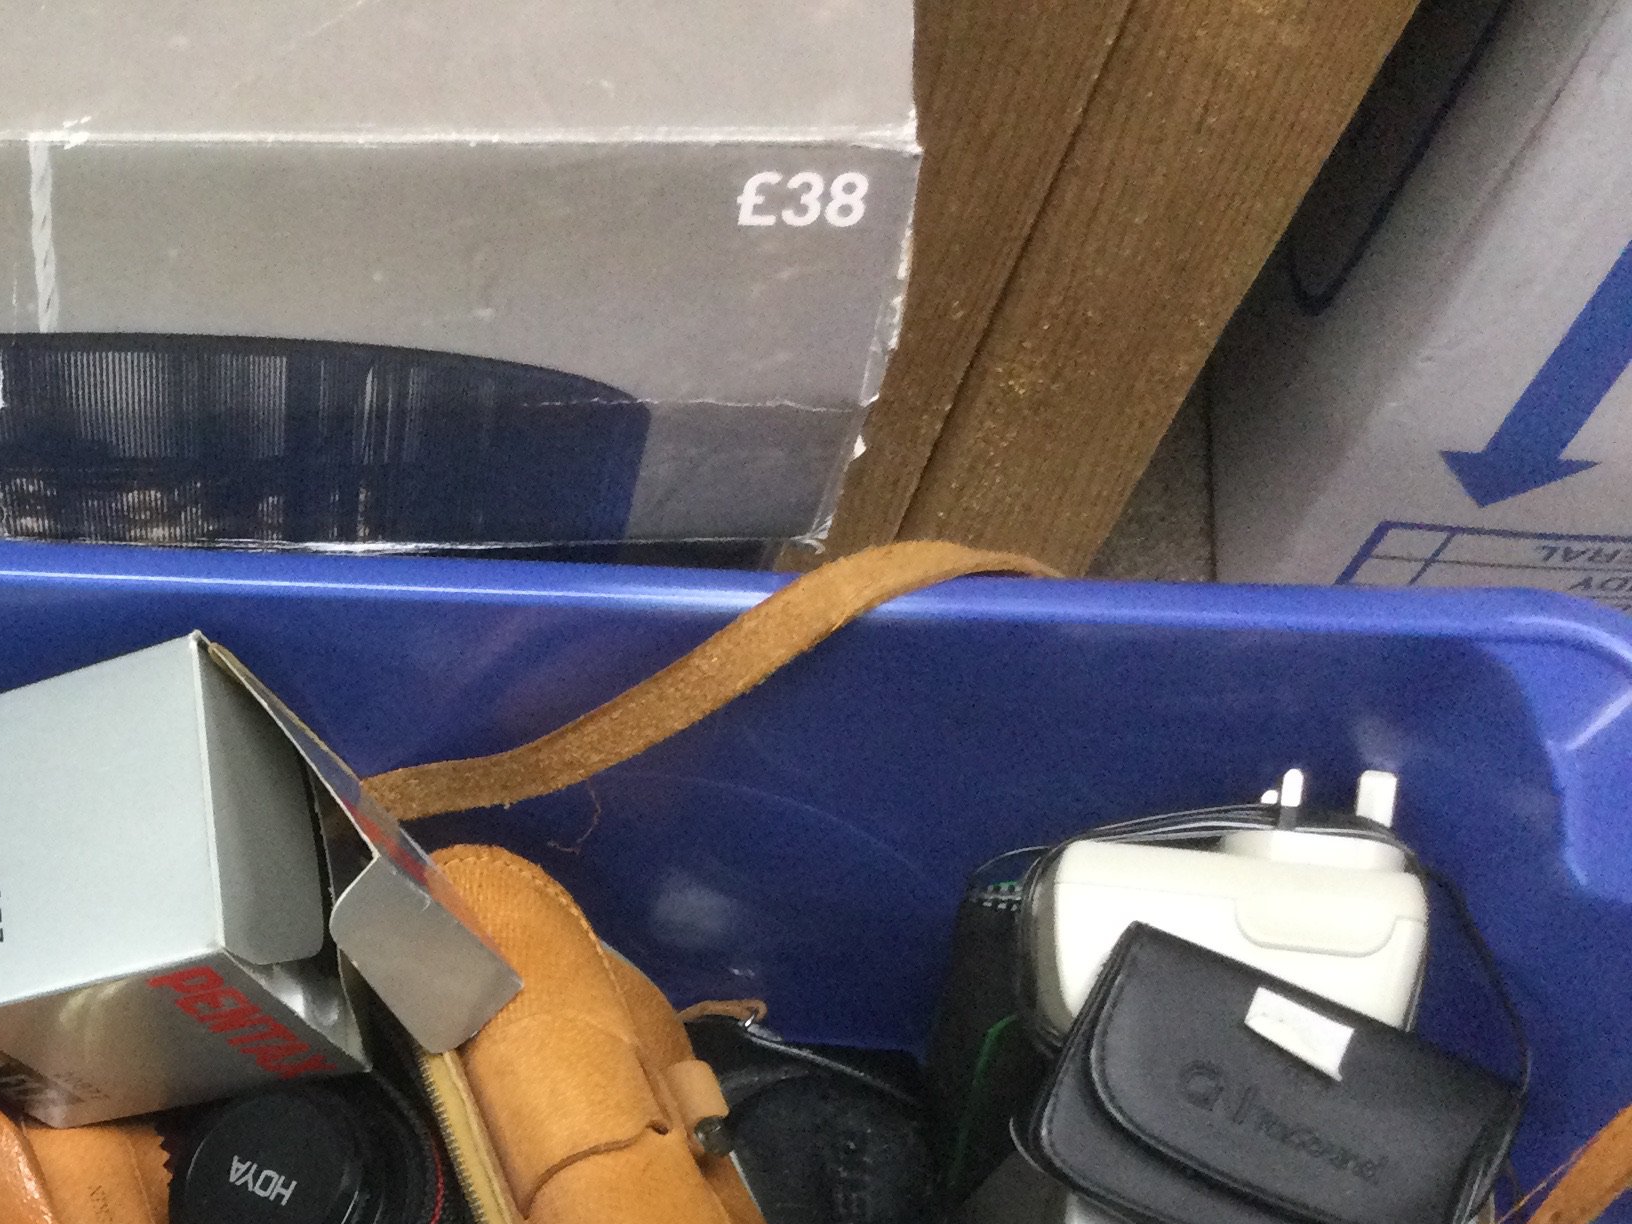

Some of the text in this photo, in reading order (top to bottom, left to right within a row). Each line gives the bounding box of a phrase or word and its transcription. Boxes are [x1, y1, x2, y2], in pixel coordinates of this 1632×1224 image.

[737, 170, 869, 228] £38
[146, 965, 338, 1081] PENTAX
[228, 1154, 299, 1208] HOYA
